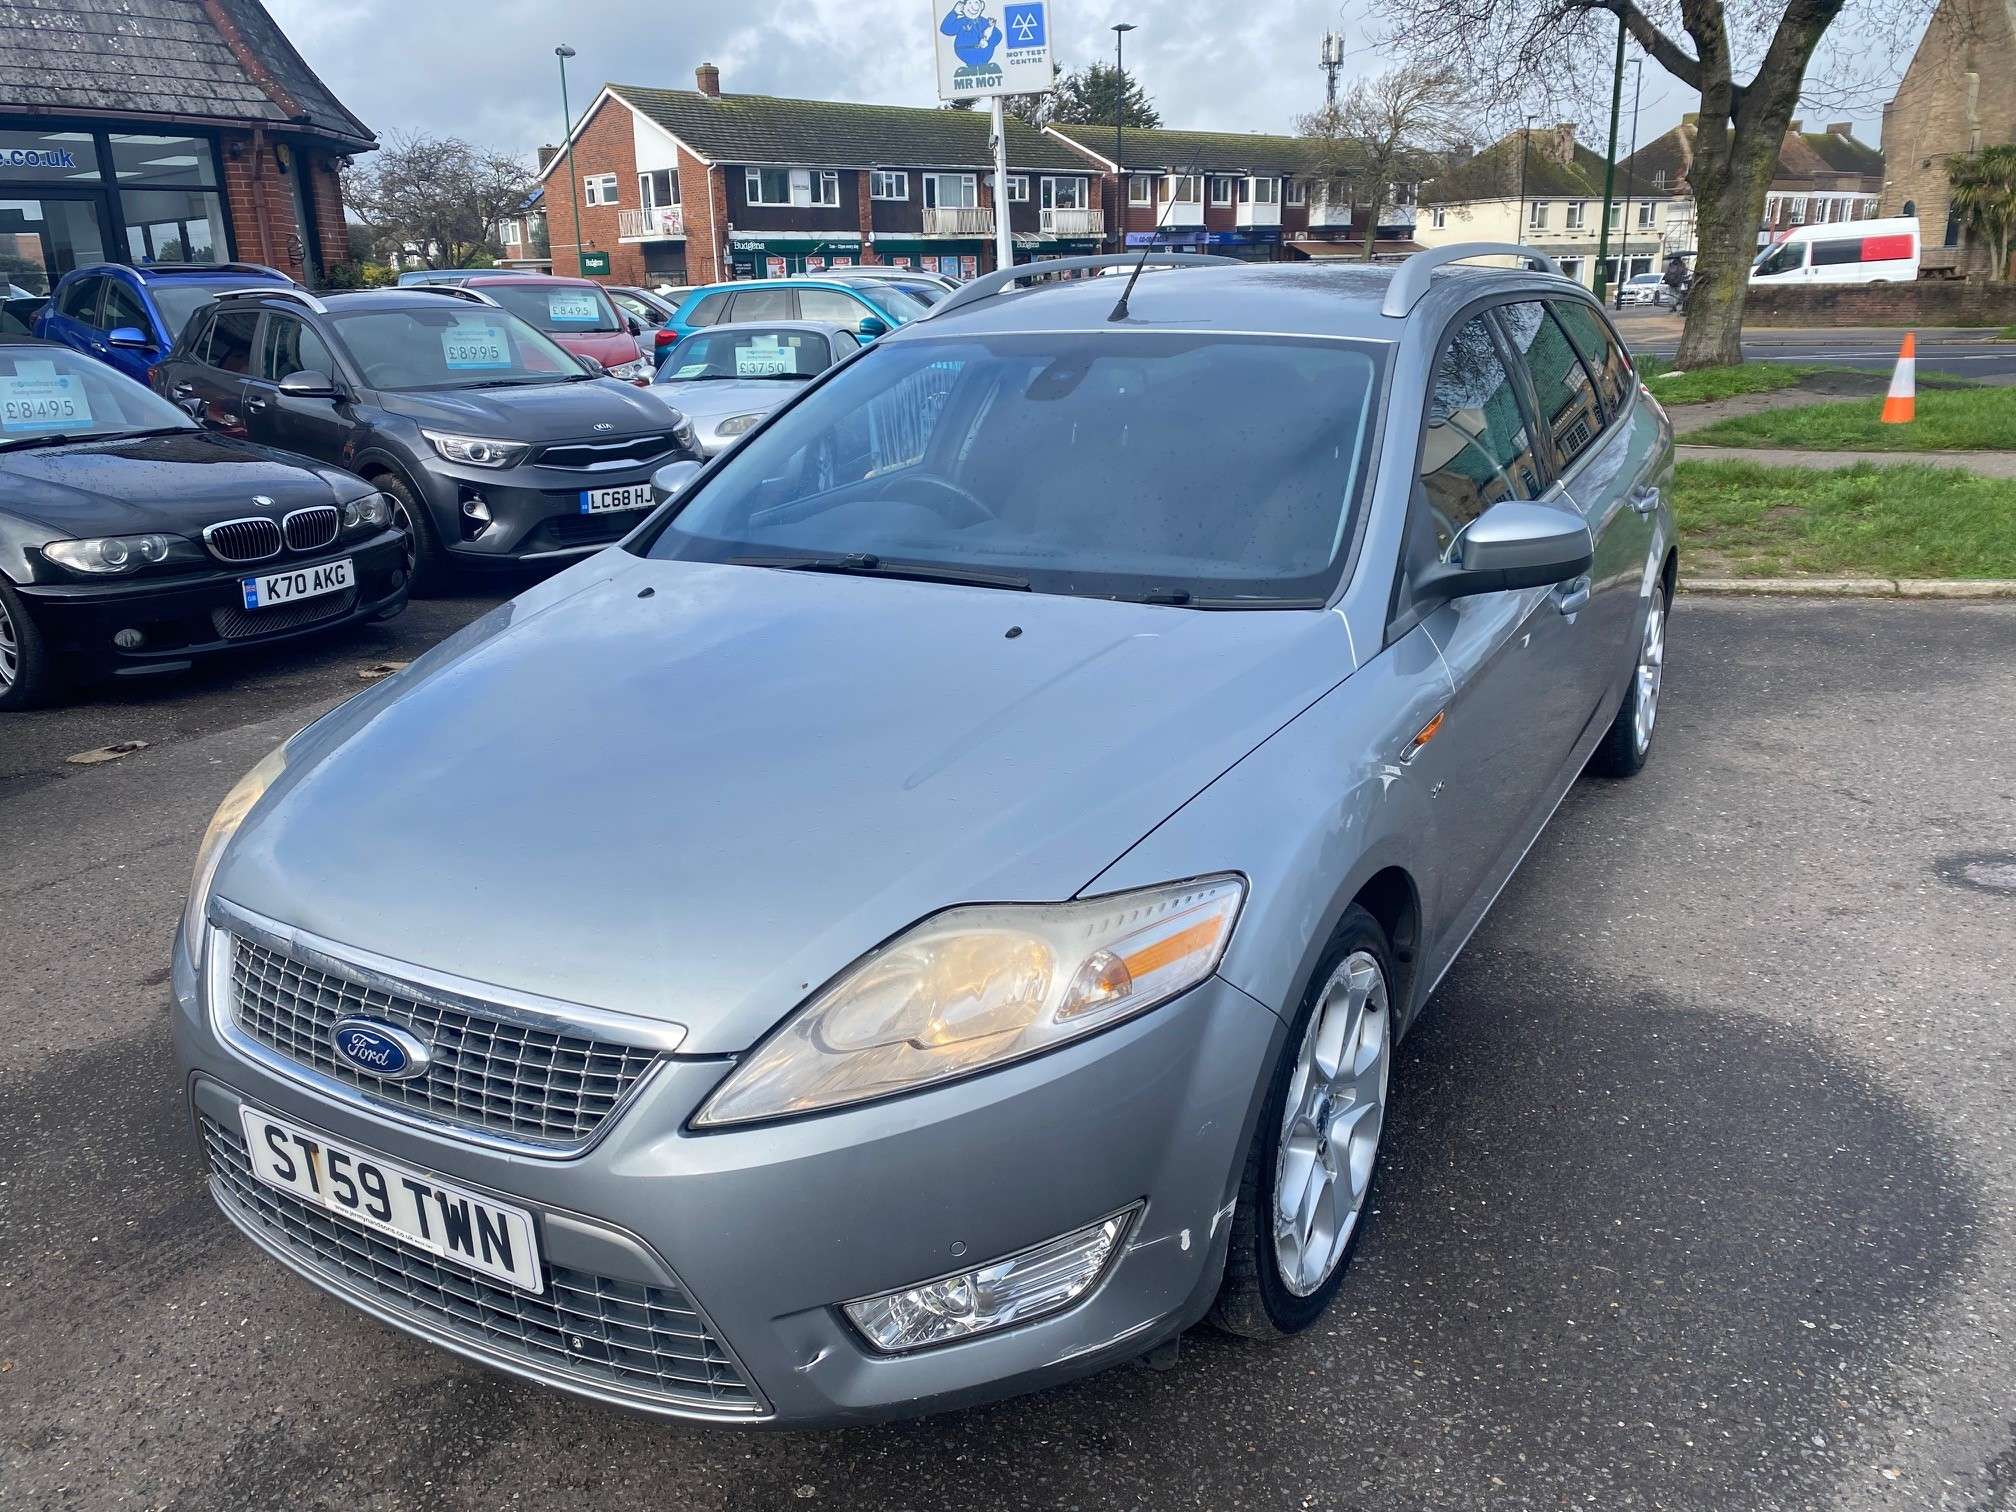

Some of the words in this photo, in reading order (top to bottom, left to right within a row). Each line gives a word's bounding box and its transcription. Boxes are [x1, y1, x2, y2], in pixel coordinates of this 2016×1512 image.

[954, 78, 973, 90] MR
[976, 76, 1003, 88] MOT
[733, 241, 765, 250] Budgens
[448, 346, 499, 360] £8995
[740, 362, 785, 374] £3750
[6, 400, 74, 419] £8495
[591, 490, 631, 509] LC68
[634, 486, 654, 504] HJ
[266, 574, 307, 600] K70
[313, 564, 346, 591] AKG
[347, 1033, 390, 1066] Ford
[264, 1124, 392, 1222] ST59
[402, 1177, 515, 1273] TWN
